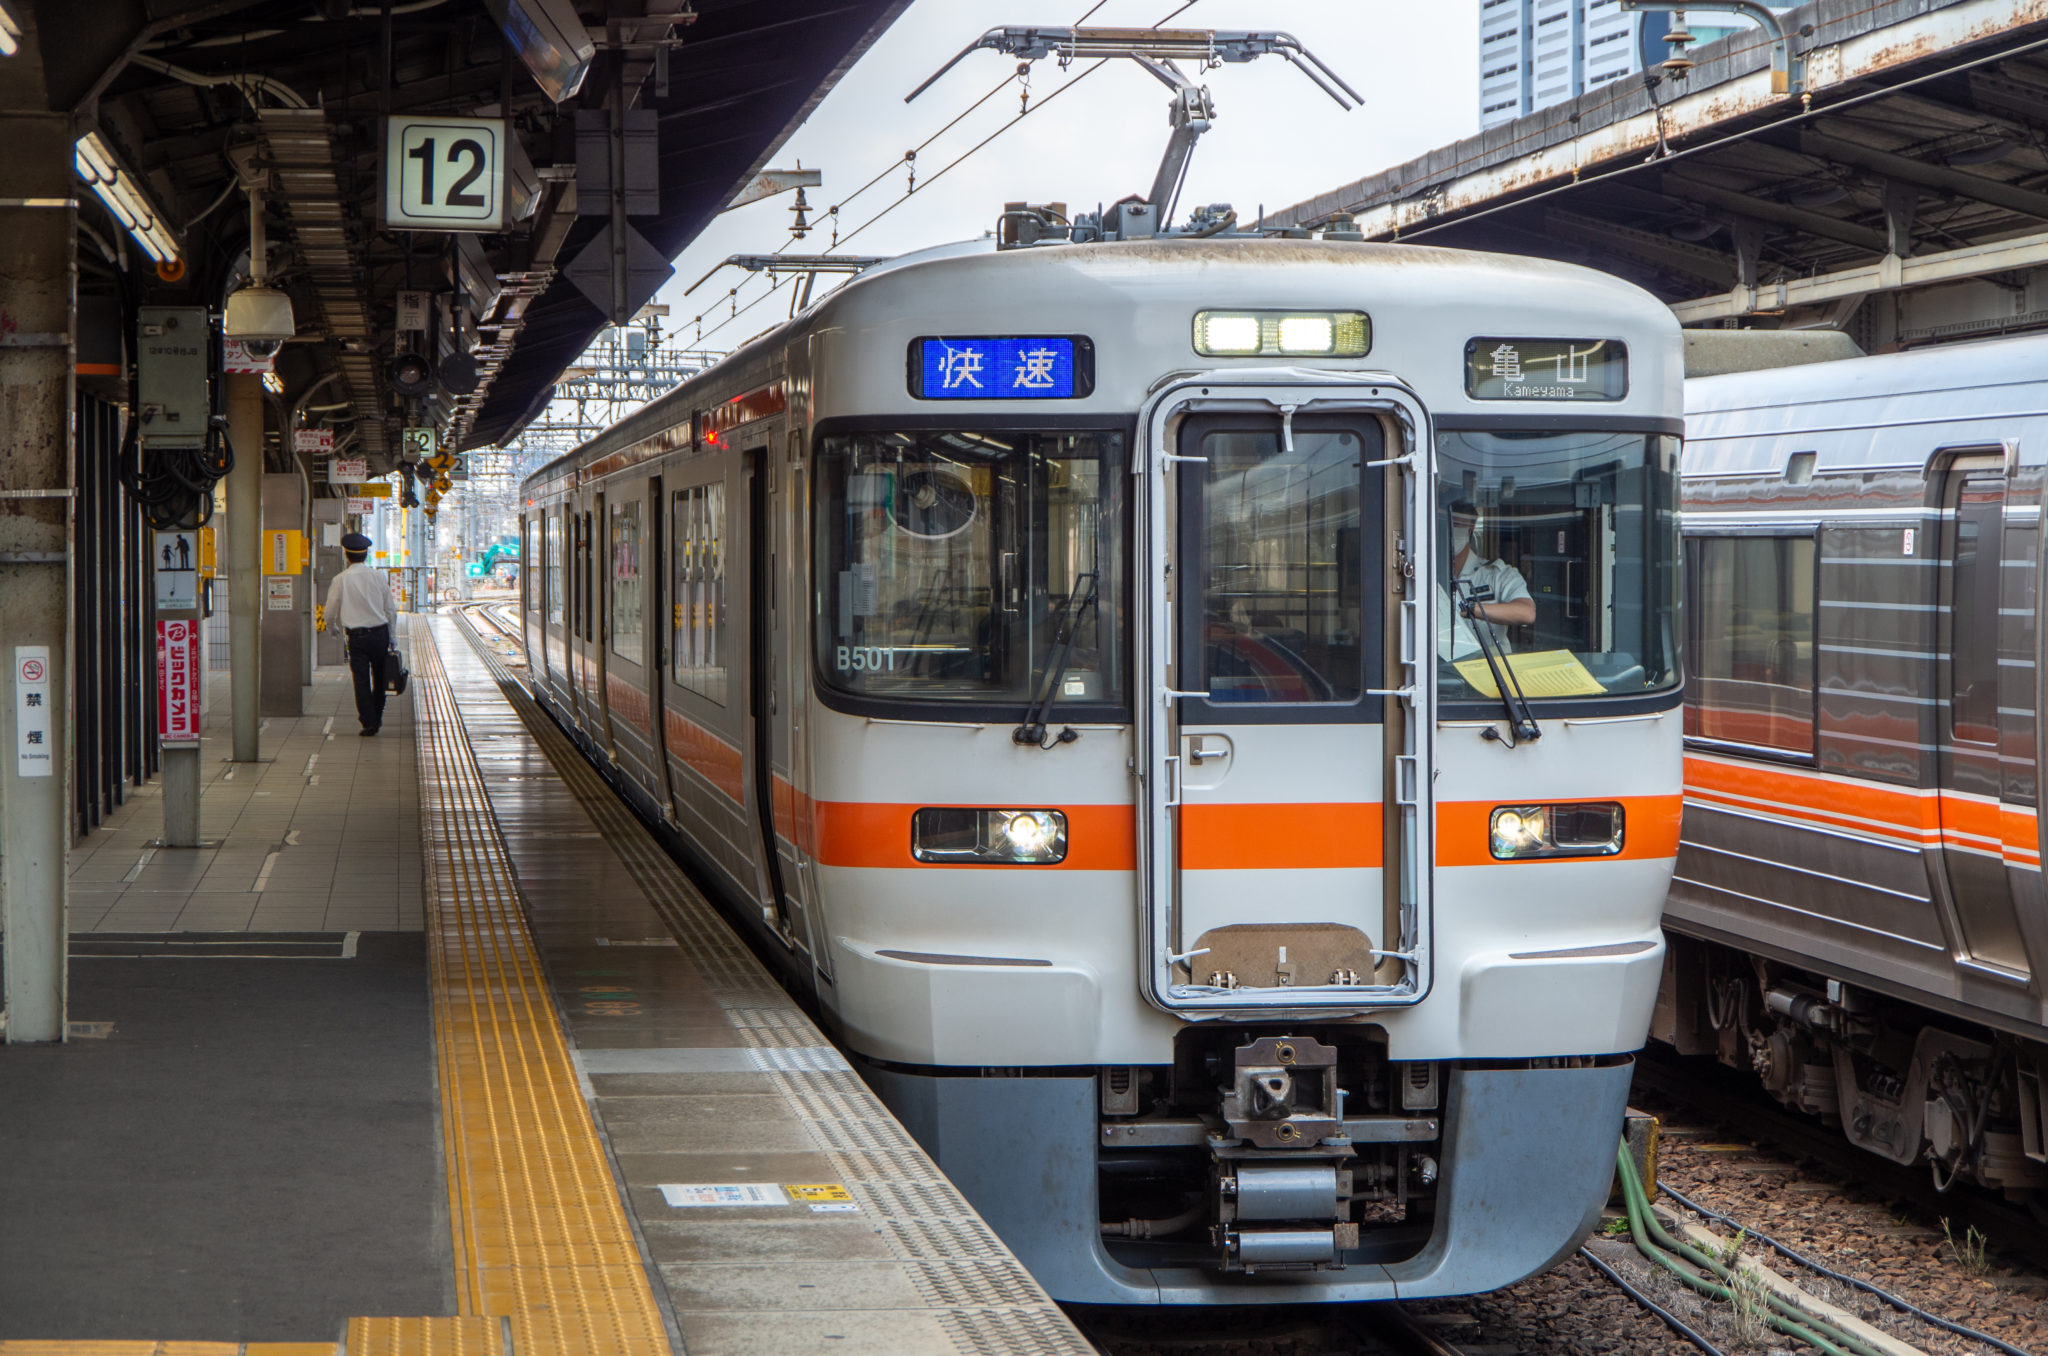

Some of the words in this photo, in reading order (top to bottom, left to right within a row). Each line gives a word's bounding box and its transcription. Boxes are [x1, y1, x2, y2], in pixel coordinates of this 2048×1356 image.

[408, 137, 486, 207] 12
[403, 294, 420, 327] 指示
[938, 347, 1058, 388] 快速
[1490, 343, 1588, 383] 亀山
[1504, 382, 1575, 398] Kameyama
[438, 451, 449, 469] 2
[440, 479, 449, 491] 3
[837, 646, 894, 671] B501
[170, 645, 186, 731] ビックカメラ
[26, 693, 43, 745] 禁煙
